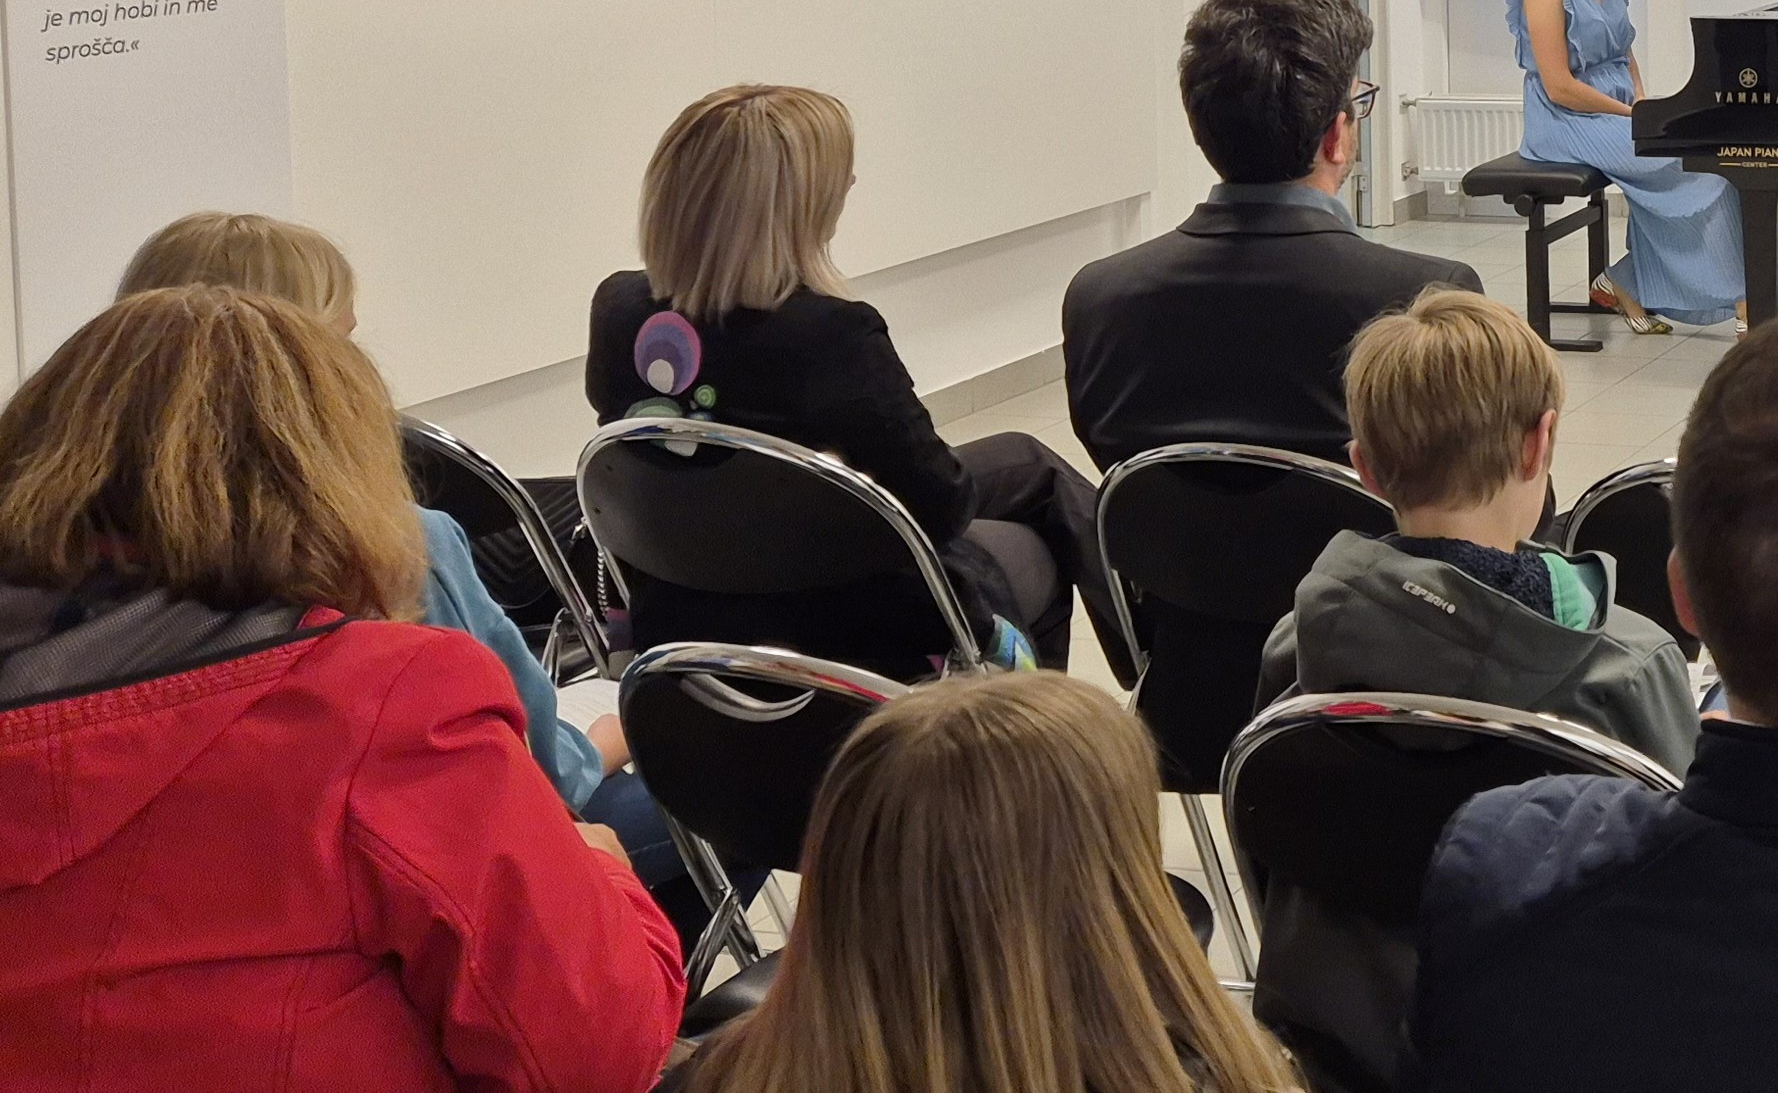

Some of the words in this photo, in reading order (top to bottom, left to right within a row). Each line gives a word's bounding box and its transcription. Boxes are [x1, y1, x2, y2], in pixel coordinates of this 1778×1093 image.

[40, 10, 62, 32] je
[69, 5, 108, 27] moj
[114, 1, 158, 21] hobi
[163, 1, 180, 16] in
[45, 37, 139, 64] sprošča.«
[1717, 147, 1752, 157] JAPAN
